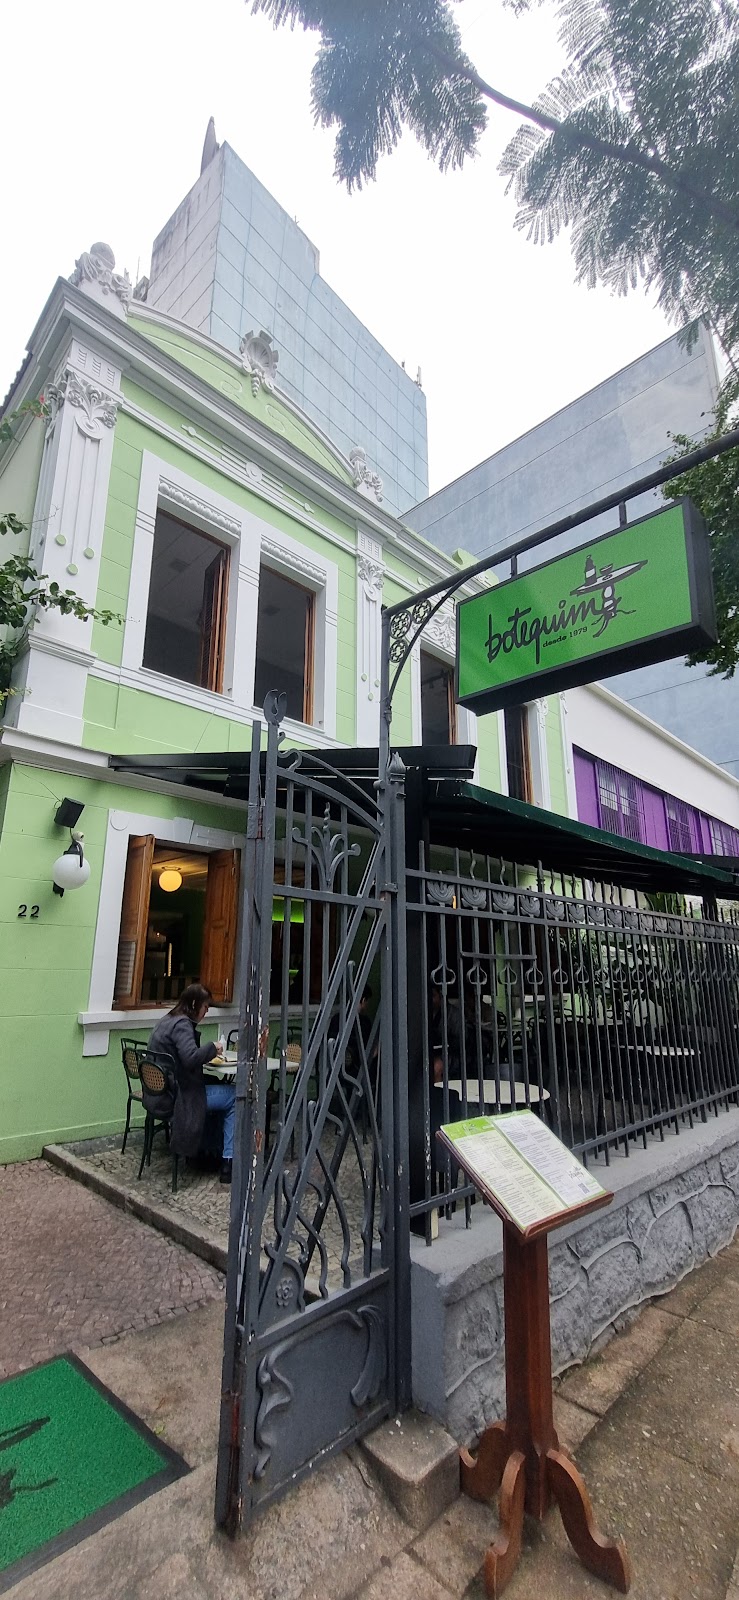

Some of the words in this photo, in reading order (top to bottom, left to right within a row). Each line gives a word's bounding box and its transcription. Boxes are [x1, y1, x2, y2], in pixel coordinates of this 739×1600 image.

[484, 597, 603, 664] botequim
[542, 635, 567, 648] desde
[569, 626, 588, 638] 1979
[17, 904, 40, 918] 22
